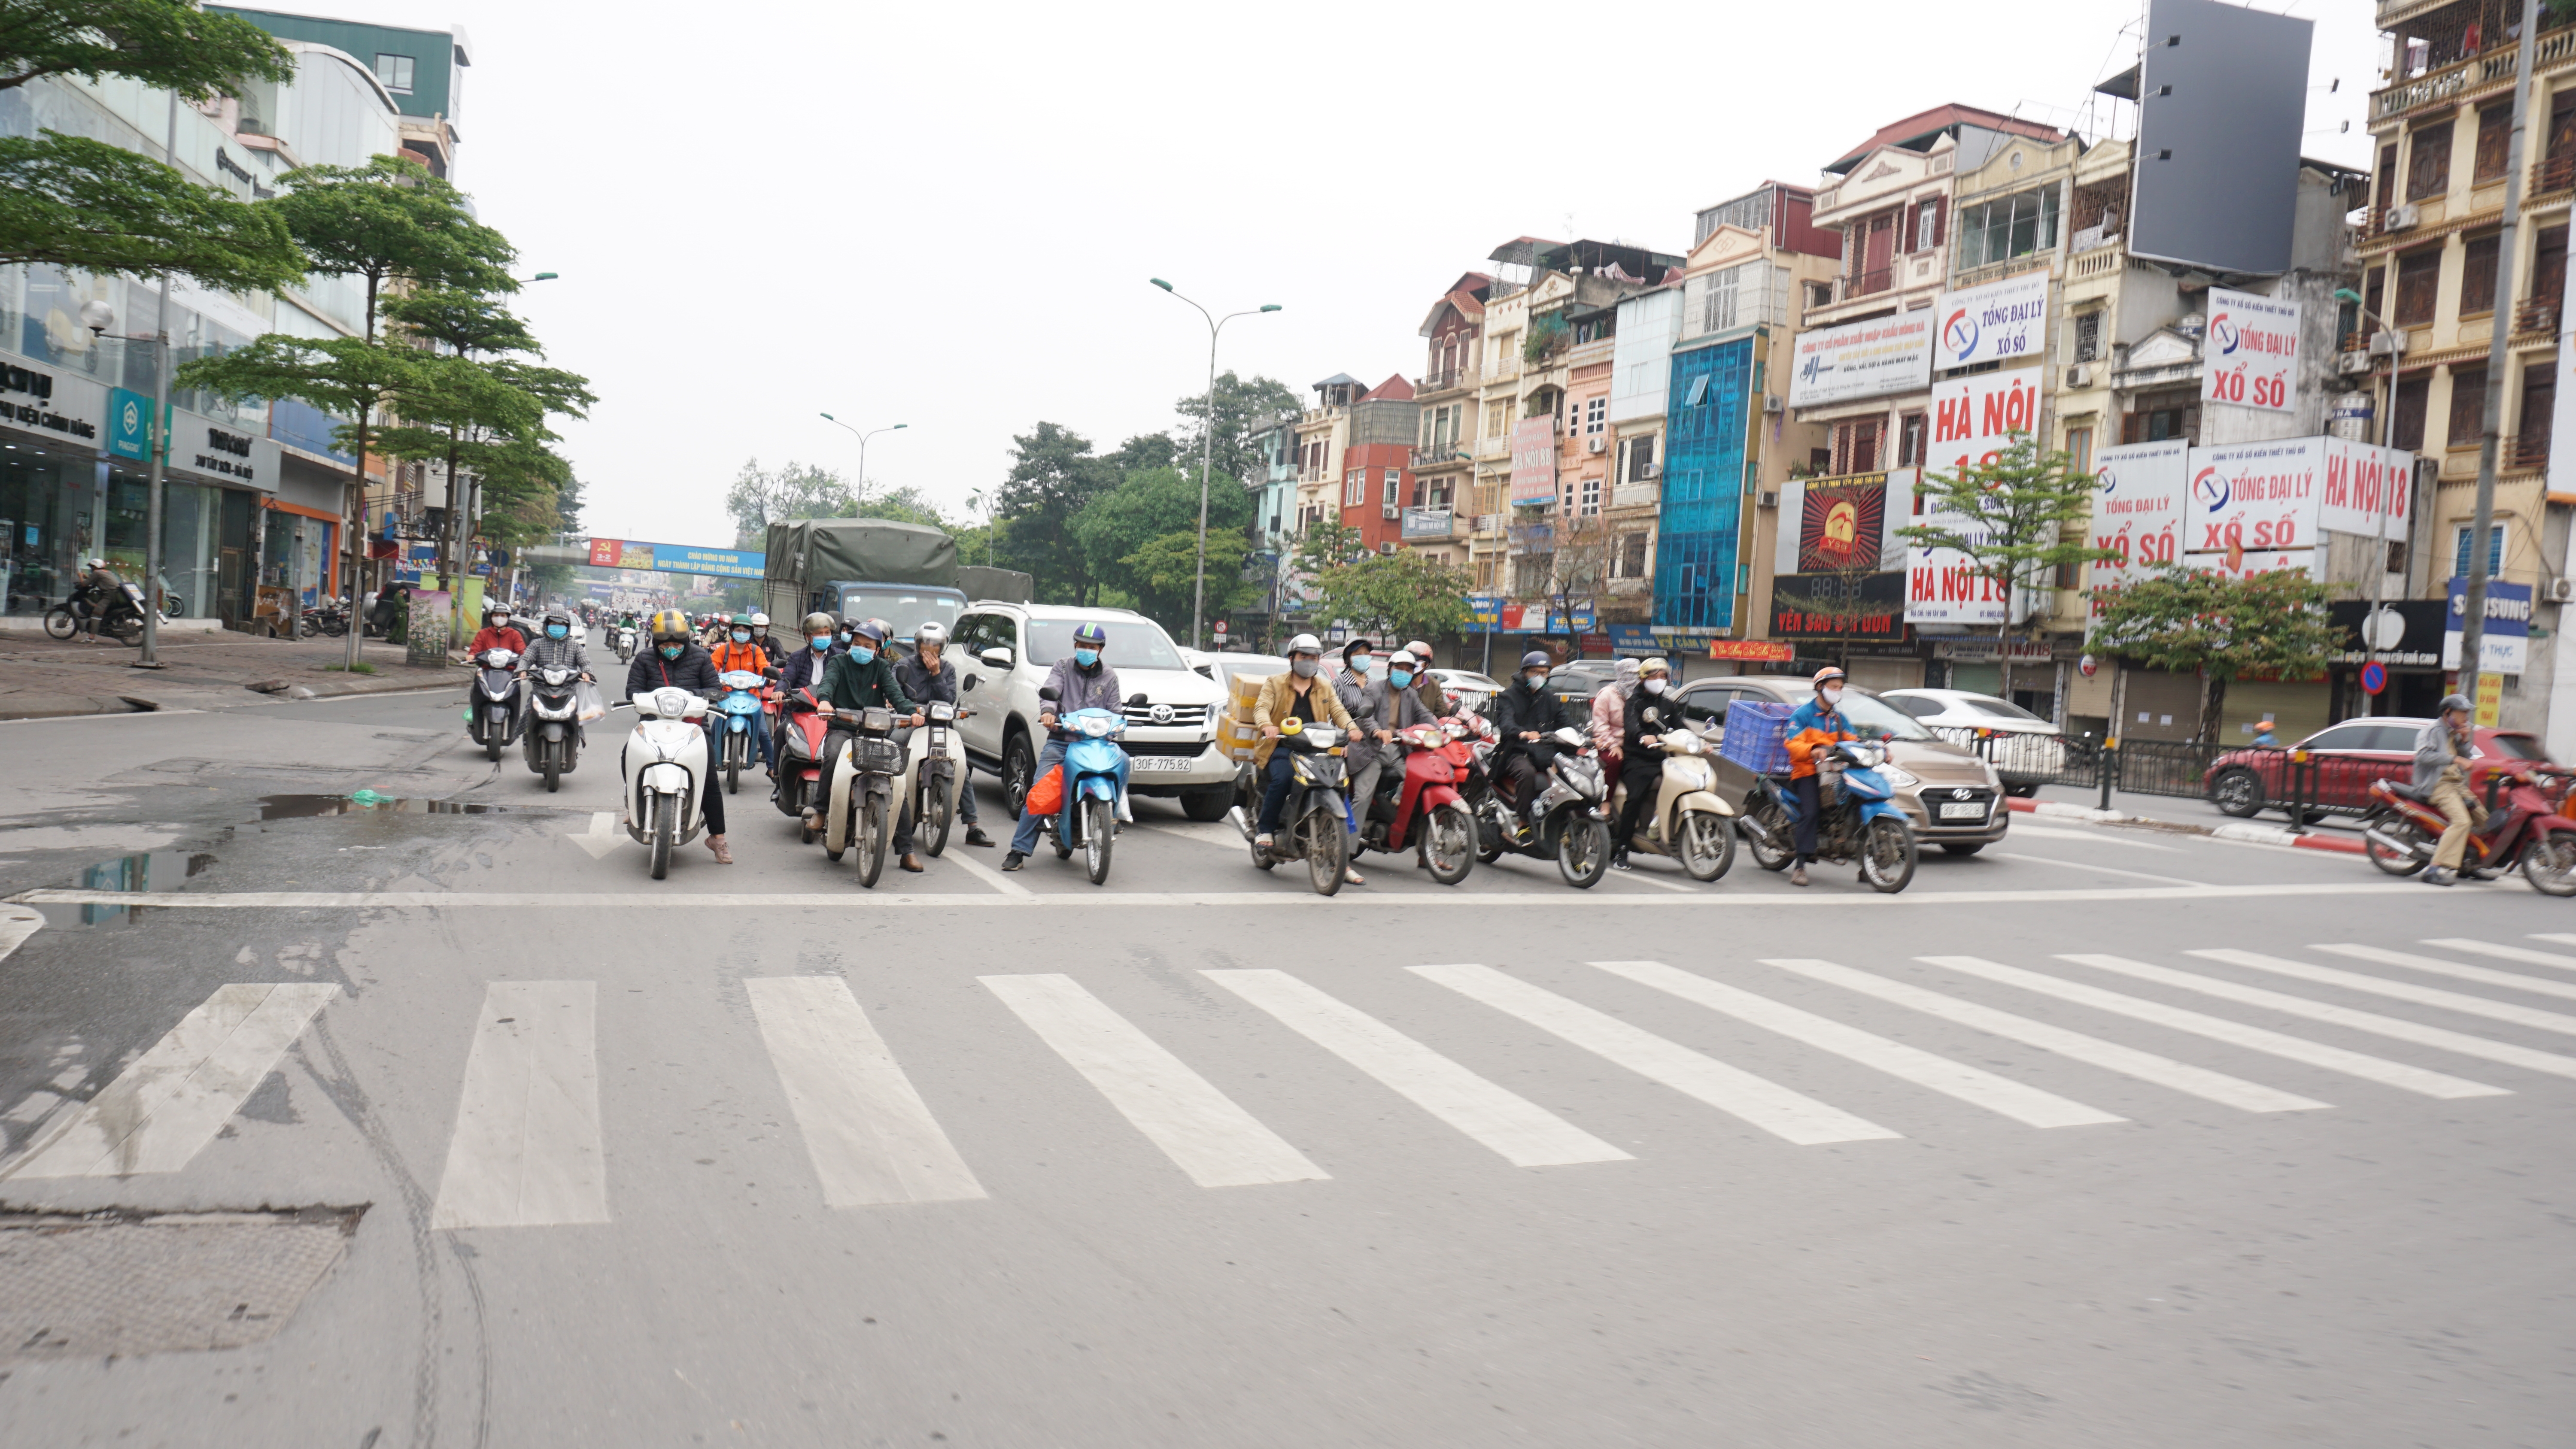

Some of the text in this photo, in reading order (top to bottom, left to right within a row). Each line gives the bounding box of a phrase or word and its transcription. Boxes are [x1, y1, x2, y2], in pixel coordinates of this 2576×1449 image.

[1982, 294, 2044, 328] TỔNG ĐẠI LÝ
[2217, 295, 2229, 305] CÔNG
[1996, 325, 2027, 355] XỔ SỐ
[2240, 321, 2296, 360] TỔNG ĐẠI LÝ
[1896, 355, 1906, 364] MAY
[2212, 361, 2288, 407] XỔ SỐ
[1936, 378, 2036, 443] HÀ NỘI
[1513, 444, 1552, 472] HÀ NỘI 8B
[2212, 453, 2227, 461] CÔNG
[1807, 482, 1819, 490] CÔNG
[2232, 466, 2313, 506] TỔNG ĐẠI LÝ
[2325, 445, 2407, 524] HÀ NỘI 18
[2106, 494, 2170, 515] TỔNG ĐẠI LÝ
[2202, 509, 2298, 549] XỔ SỐ
[688, 552, 702, 560] CHÀO
[703, 552, 717, 561] MỪNG
[726, 555, 738, 563] NĂM
[2095, 520, 2132, 570] XỔ
[2139, 518, 2177, 567] SỐ
[673, 561, 689, 570] THÀNH
[690, 561, 700, 572] LẬP
[701, 562, 715, 571] ĐẢNG
[716, 564, 730, 574] CỘNG
[731, 564, 741, 574] SẢN
[743, 566, 752, 576] VIỆT
[1912, 558, 1935, 602] HÀ
[1942, 558, 1975, 609] NỘI
[1771, 644, 1785, 653] 2020
[1136, 758, 1189, 770] 30F-775.82
